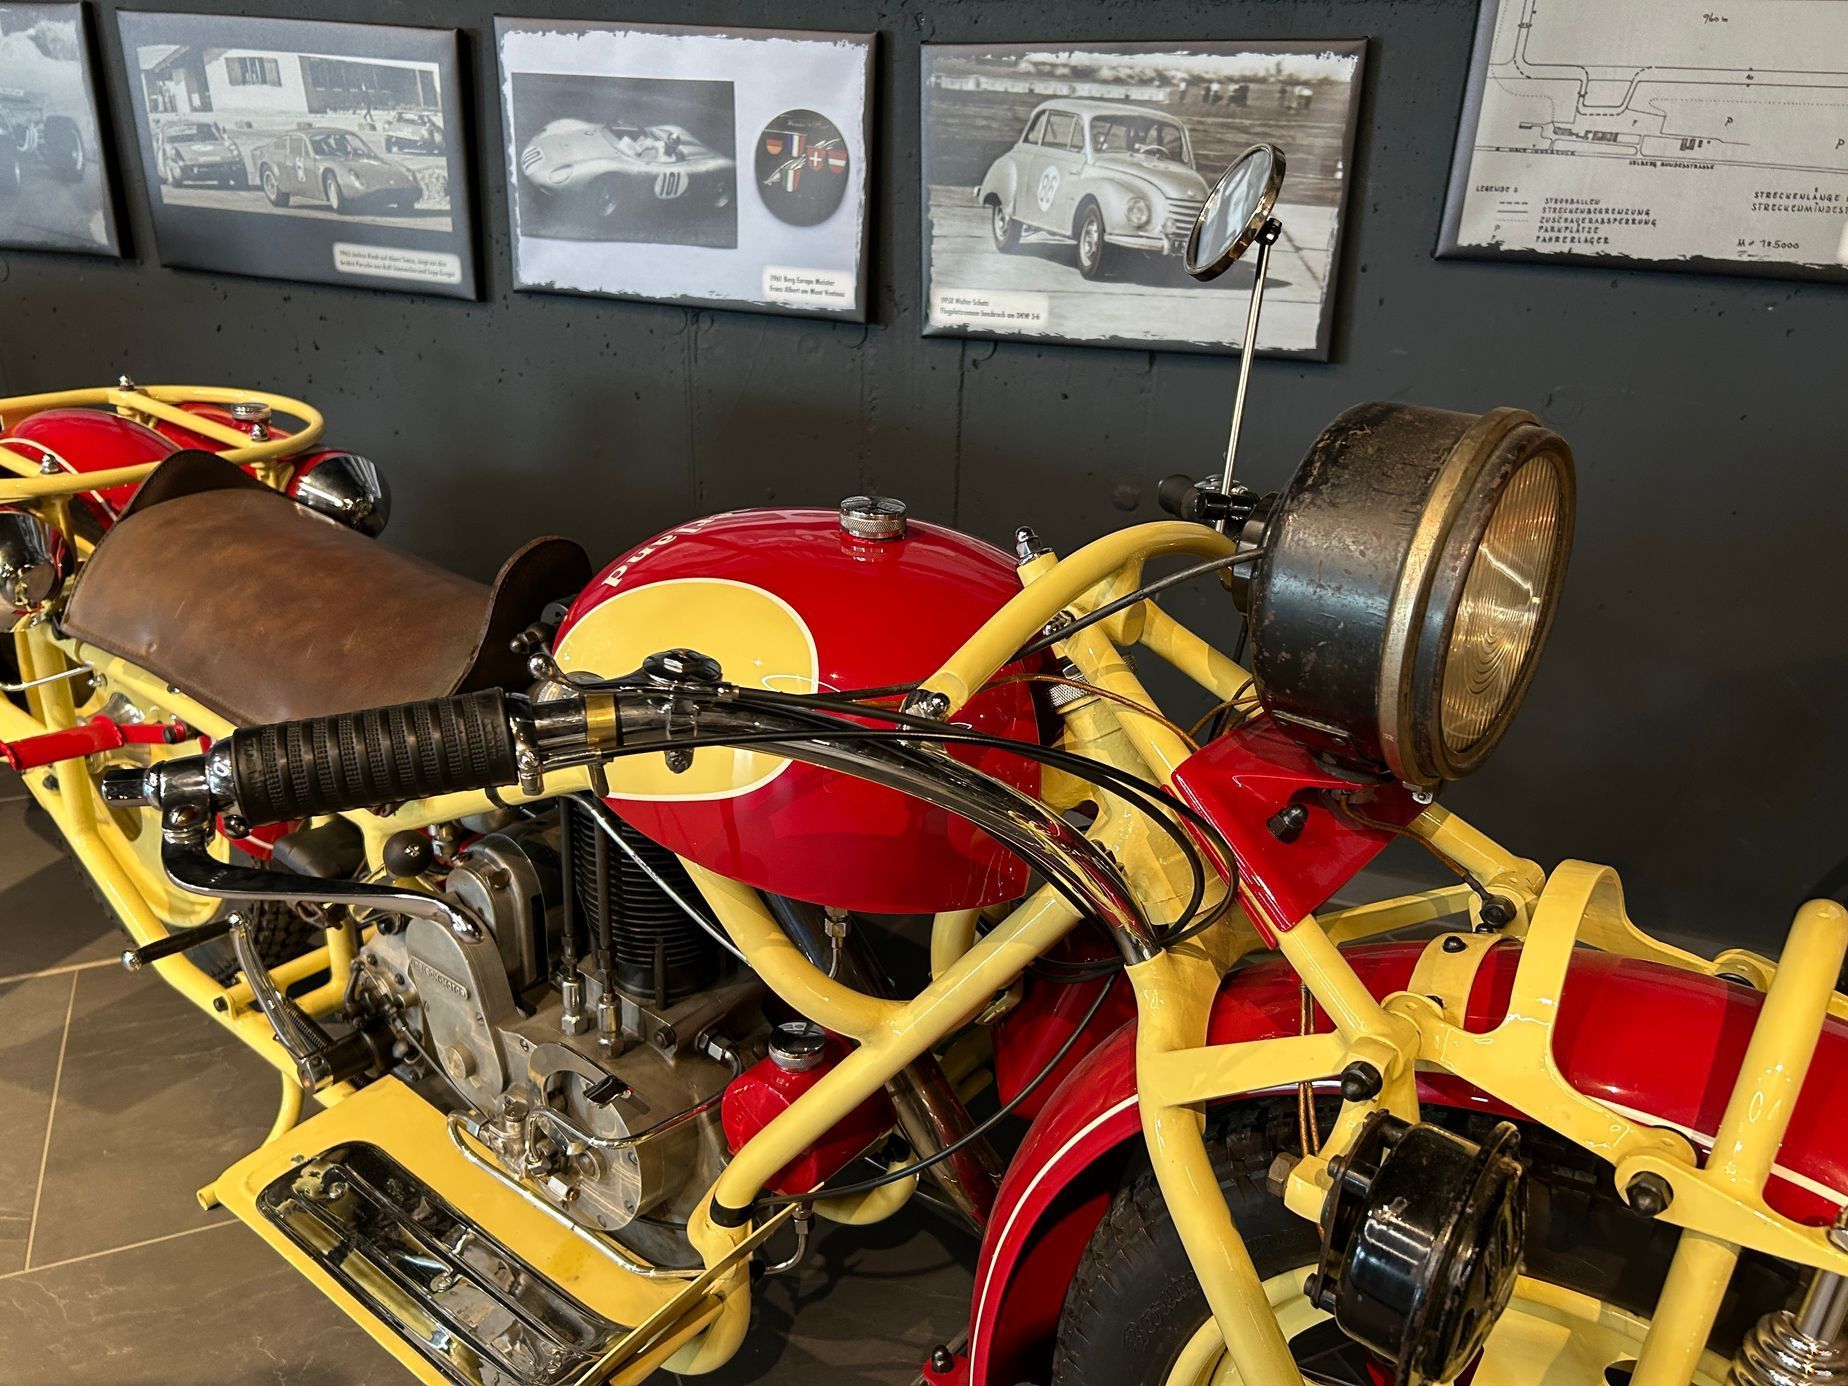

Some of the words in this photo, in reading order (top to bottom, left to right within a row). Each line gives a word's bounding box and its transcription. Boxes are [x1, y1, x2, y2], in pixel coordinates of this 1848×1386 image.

[1724, 116, 1734, 127] P
[1836, 138, 1846, 150] P
[660, 172, 681, 196] 101
[1544, 197, 1601, 205] STROHBALLEN
[1541, 206, 1651, 216] STRECKENBEGRENZUNG
[1539, 216, 1657, 228] ZUSCHAUERABSPERRUNG
[1538, 223, 1600, 234] PARKPLÄTZE
[1535, 235, 1609, 245] FAHRERLAGER
[1737, 239, 1746, 247] M
